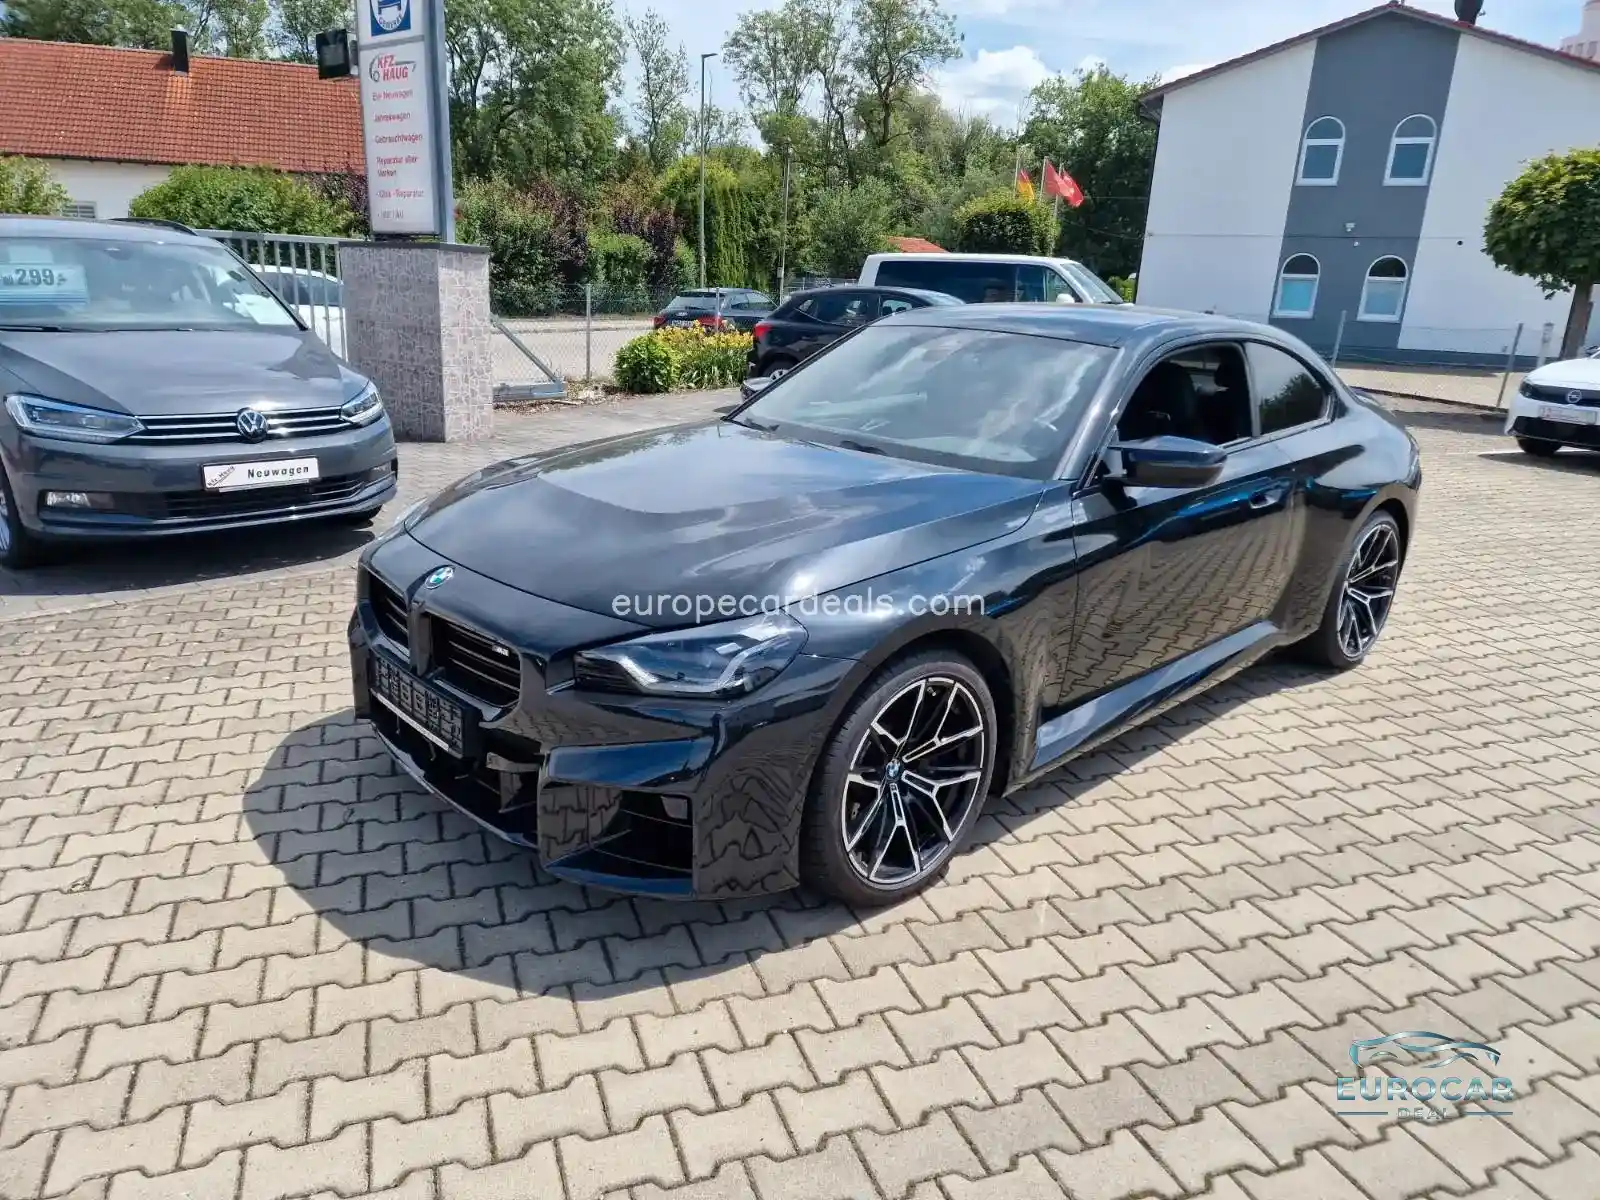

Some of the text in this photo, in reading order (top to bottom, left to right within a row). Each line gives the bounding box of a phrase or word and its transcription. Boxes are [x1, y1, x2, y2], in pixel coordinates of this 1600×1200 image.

[377, 54, 395, 69] KFZ
[382, 66, 409, 81] HAUG
[247, 466, 309, 479] Neuwagen
